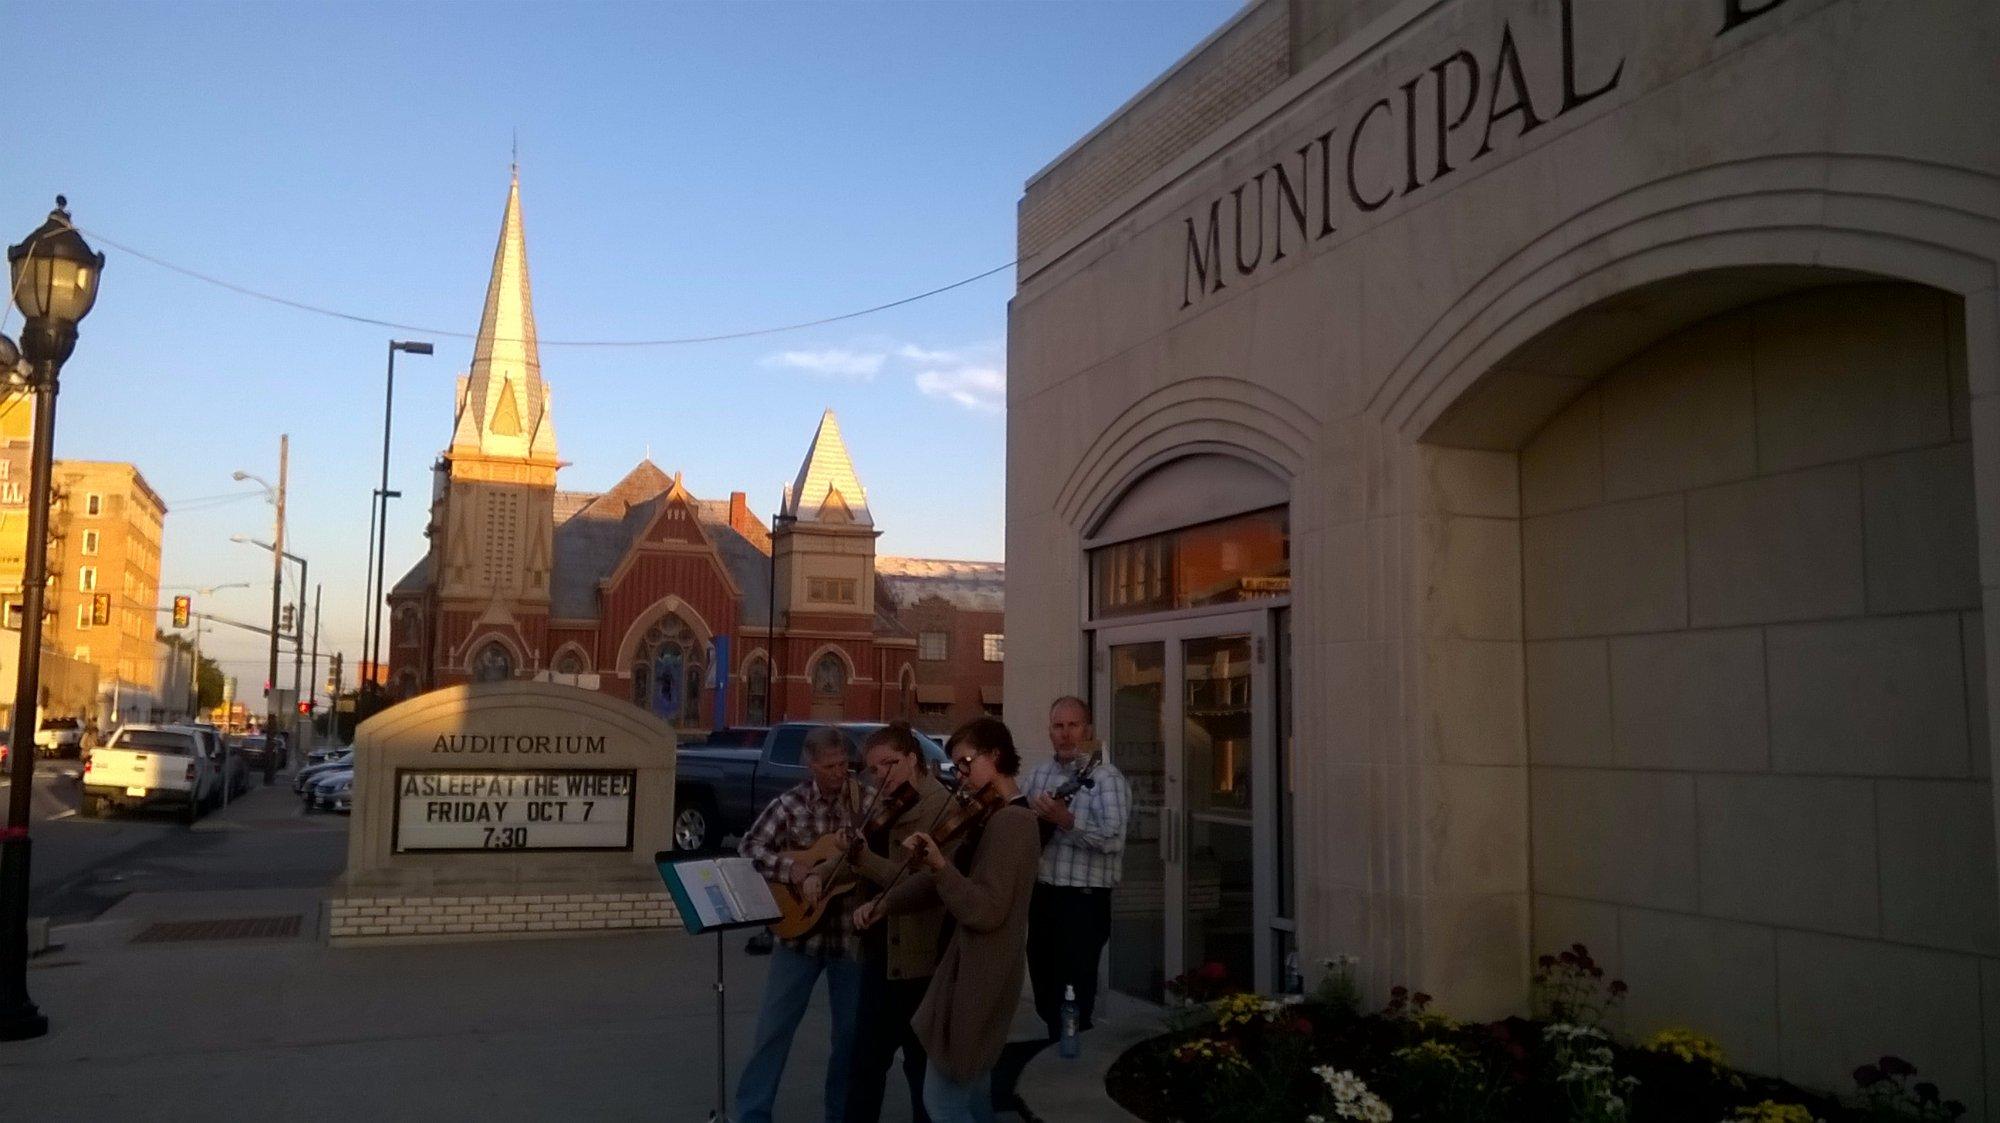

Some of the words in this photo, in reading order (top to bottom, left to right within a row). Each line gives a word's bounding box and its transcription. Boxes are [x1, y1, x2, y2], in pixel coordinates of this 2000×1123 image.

[1180, 0, 1626, 311] MUNICIPAL
[432, 734, 606, 754] AUDITORIUM
[404, 775, 486, 797] ASLEEP
[487, 775, 514, 797] AT
[523, 775, 560, 797] THE
[427, 801, 508, 823] FRIDAY
[527, 801, 568, 823] OCT
[583, 801, 595, 822] 7
[484, 827, 528, 848] 7:30
